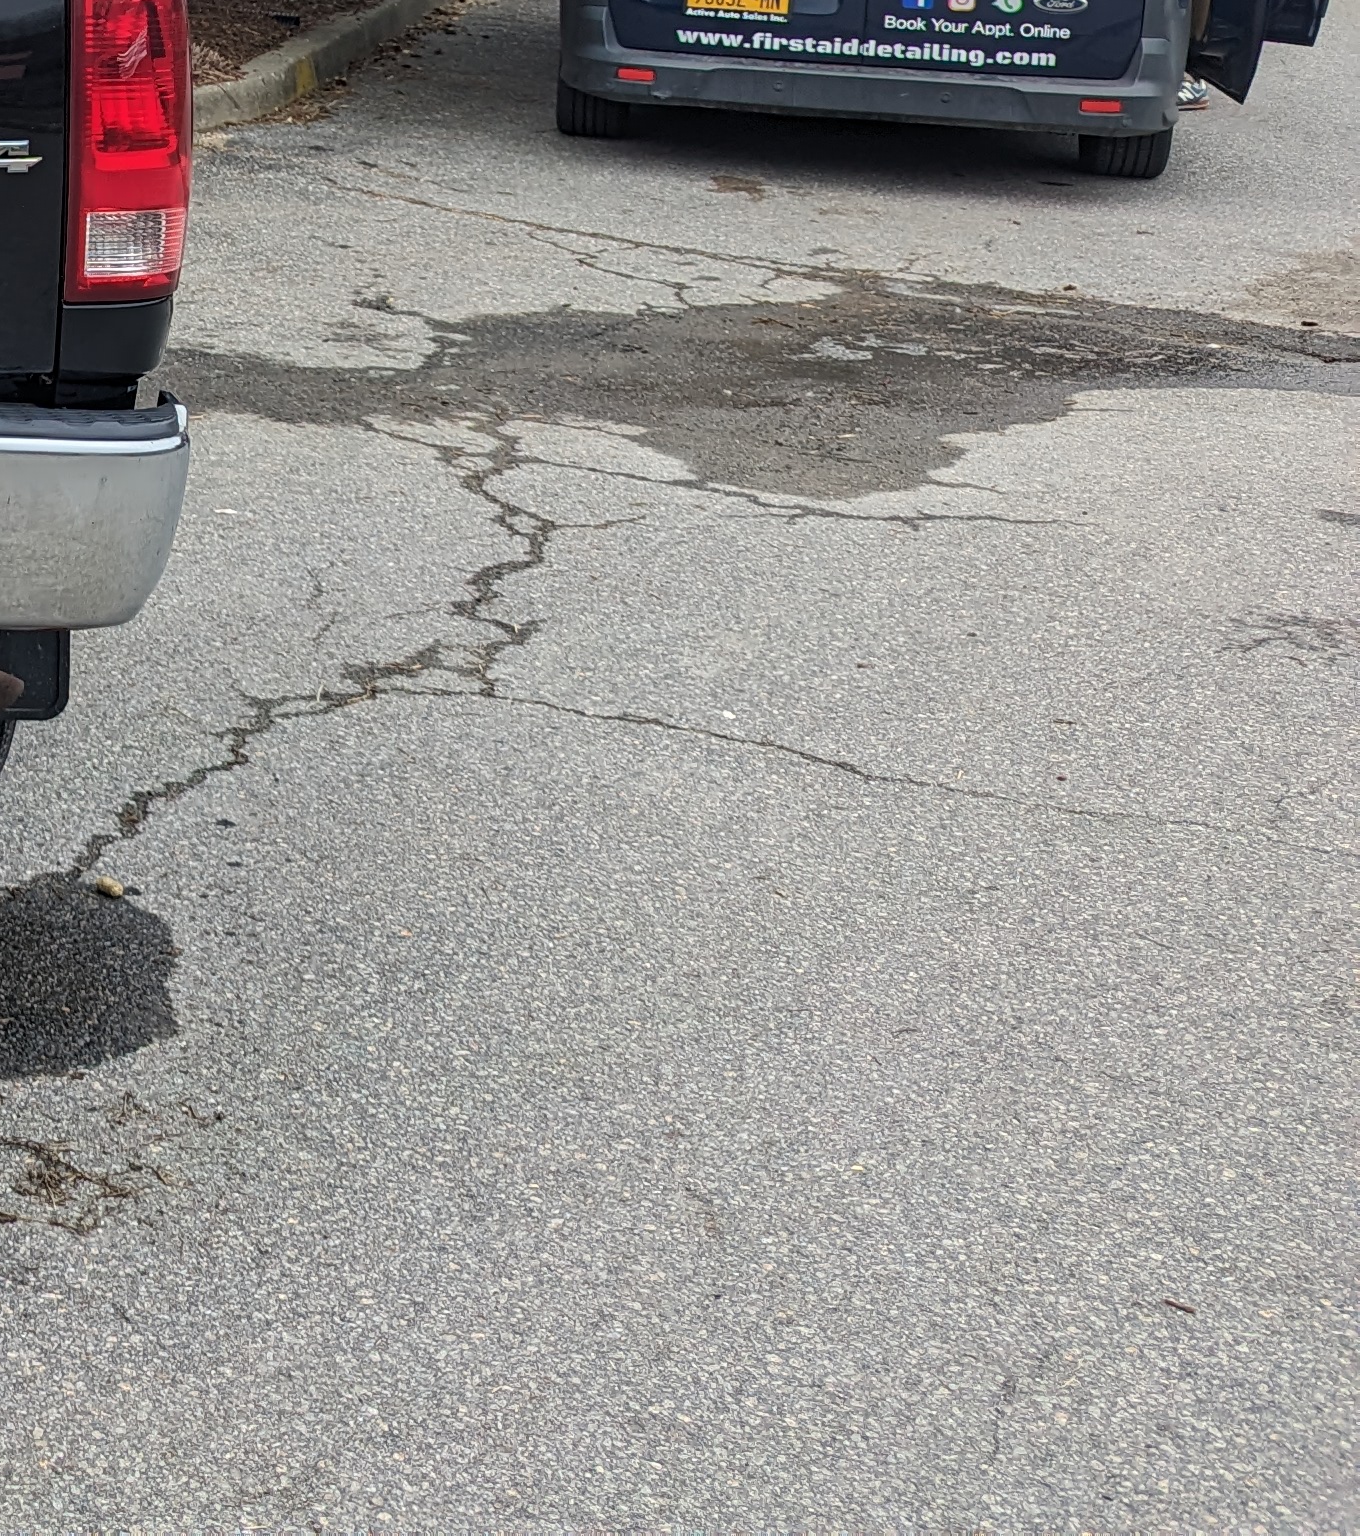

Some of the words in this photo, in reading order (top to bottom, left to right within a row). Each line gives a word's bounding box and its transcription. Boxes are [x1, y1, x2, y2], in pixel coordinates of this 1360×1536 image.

[685, 8, 715, 17] Active
[717, 10, 740, 19] Auto
[742, 11, 768, 21] Sales
[884, 15, 927, 31] Book
[932, 18, 969, 34] Your
[971, 20, 1014, 39] Appt.
[1020, 23, 1071, 40] Online
[676, 30, 1056, 67] www.firstaiddetailing.com
